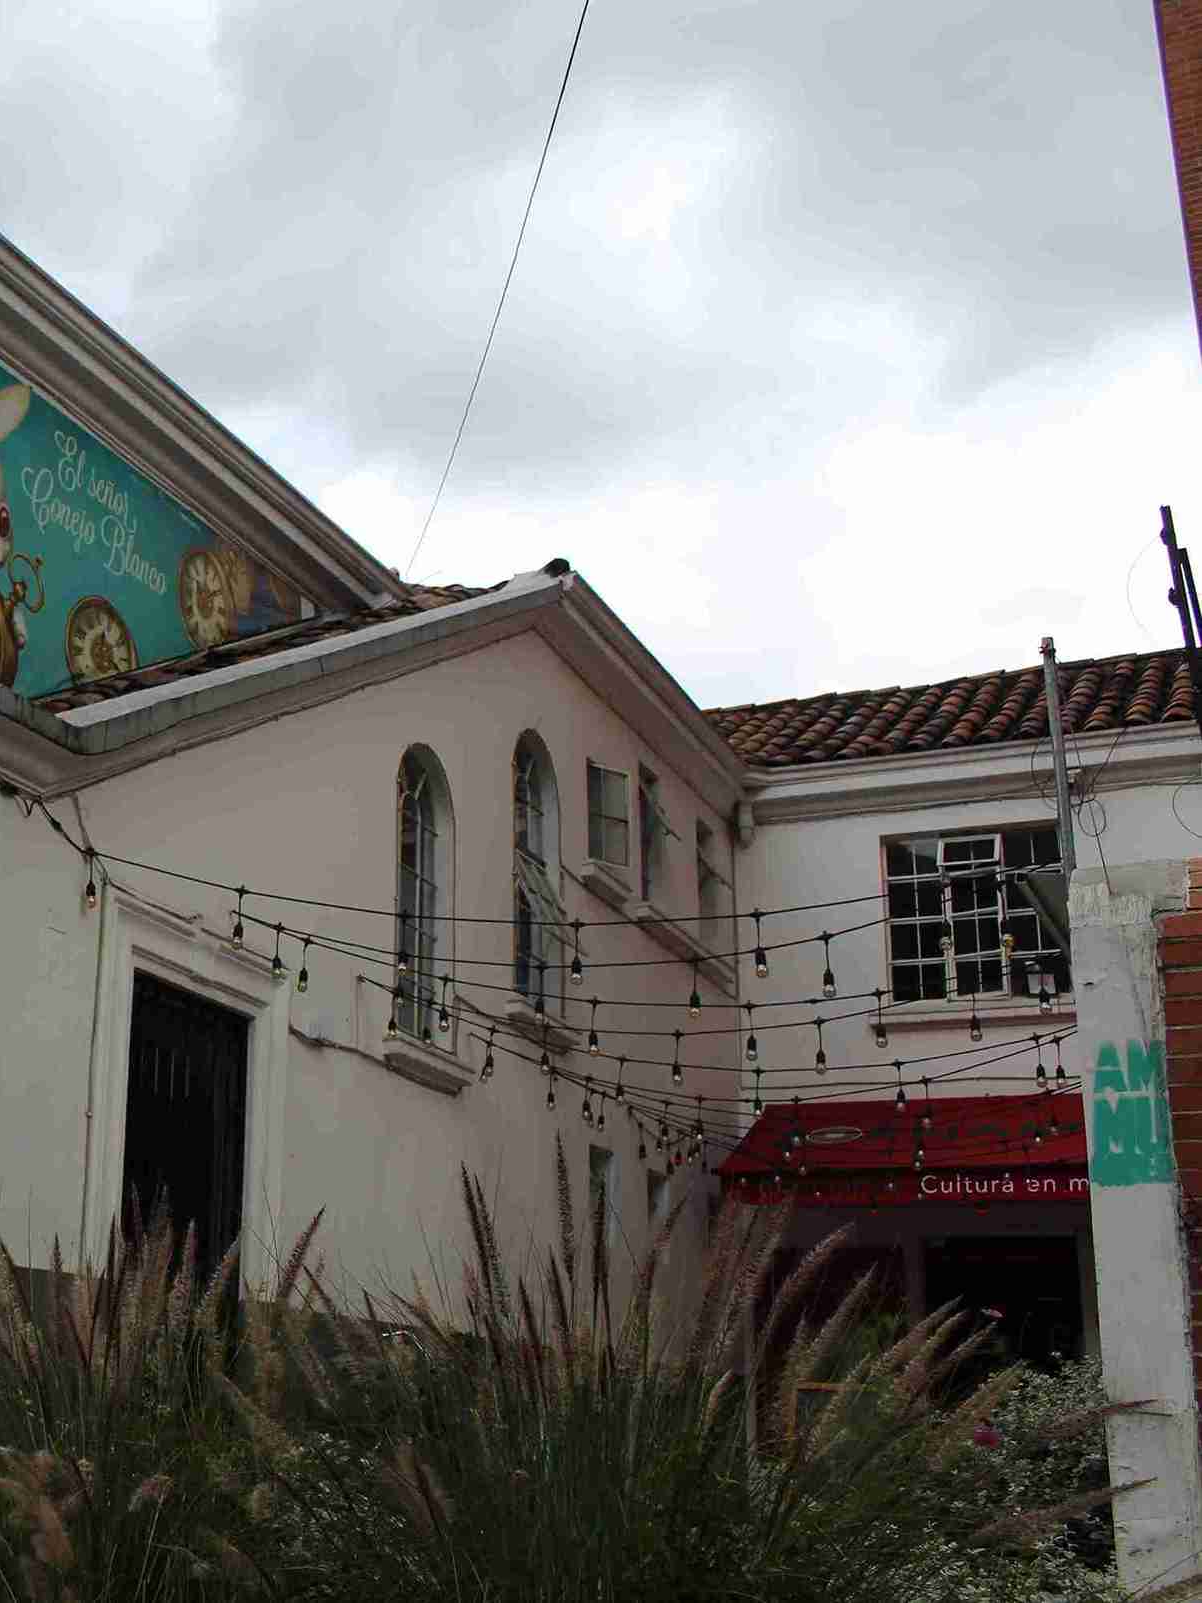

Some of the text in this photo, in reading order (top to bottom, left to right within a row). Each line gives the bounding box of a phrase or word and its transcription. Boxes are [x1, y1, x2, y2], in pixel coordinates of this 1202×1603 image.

[54, 430, 86, 490] El
[22, 467, 166, 594] Conejo Blanco
[921, 1174, 1014, 1194] Cultura
[1027, 1178, 1056, 1193] en
